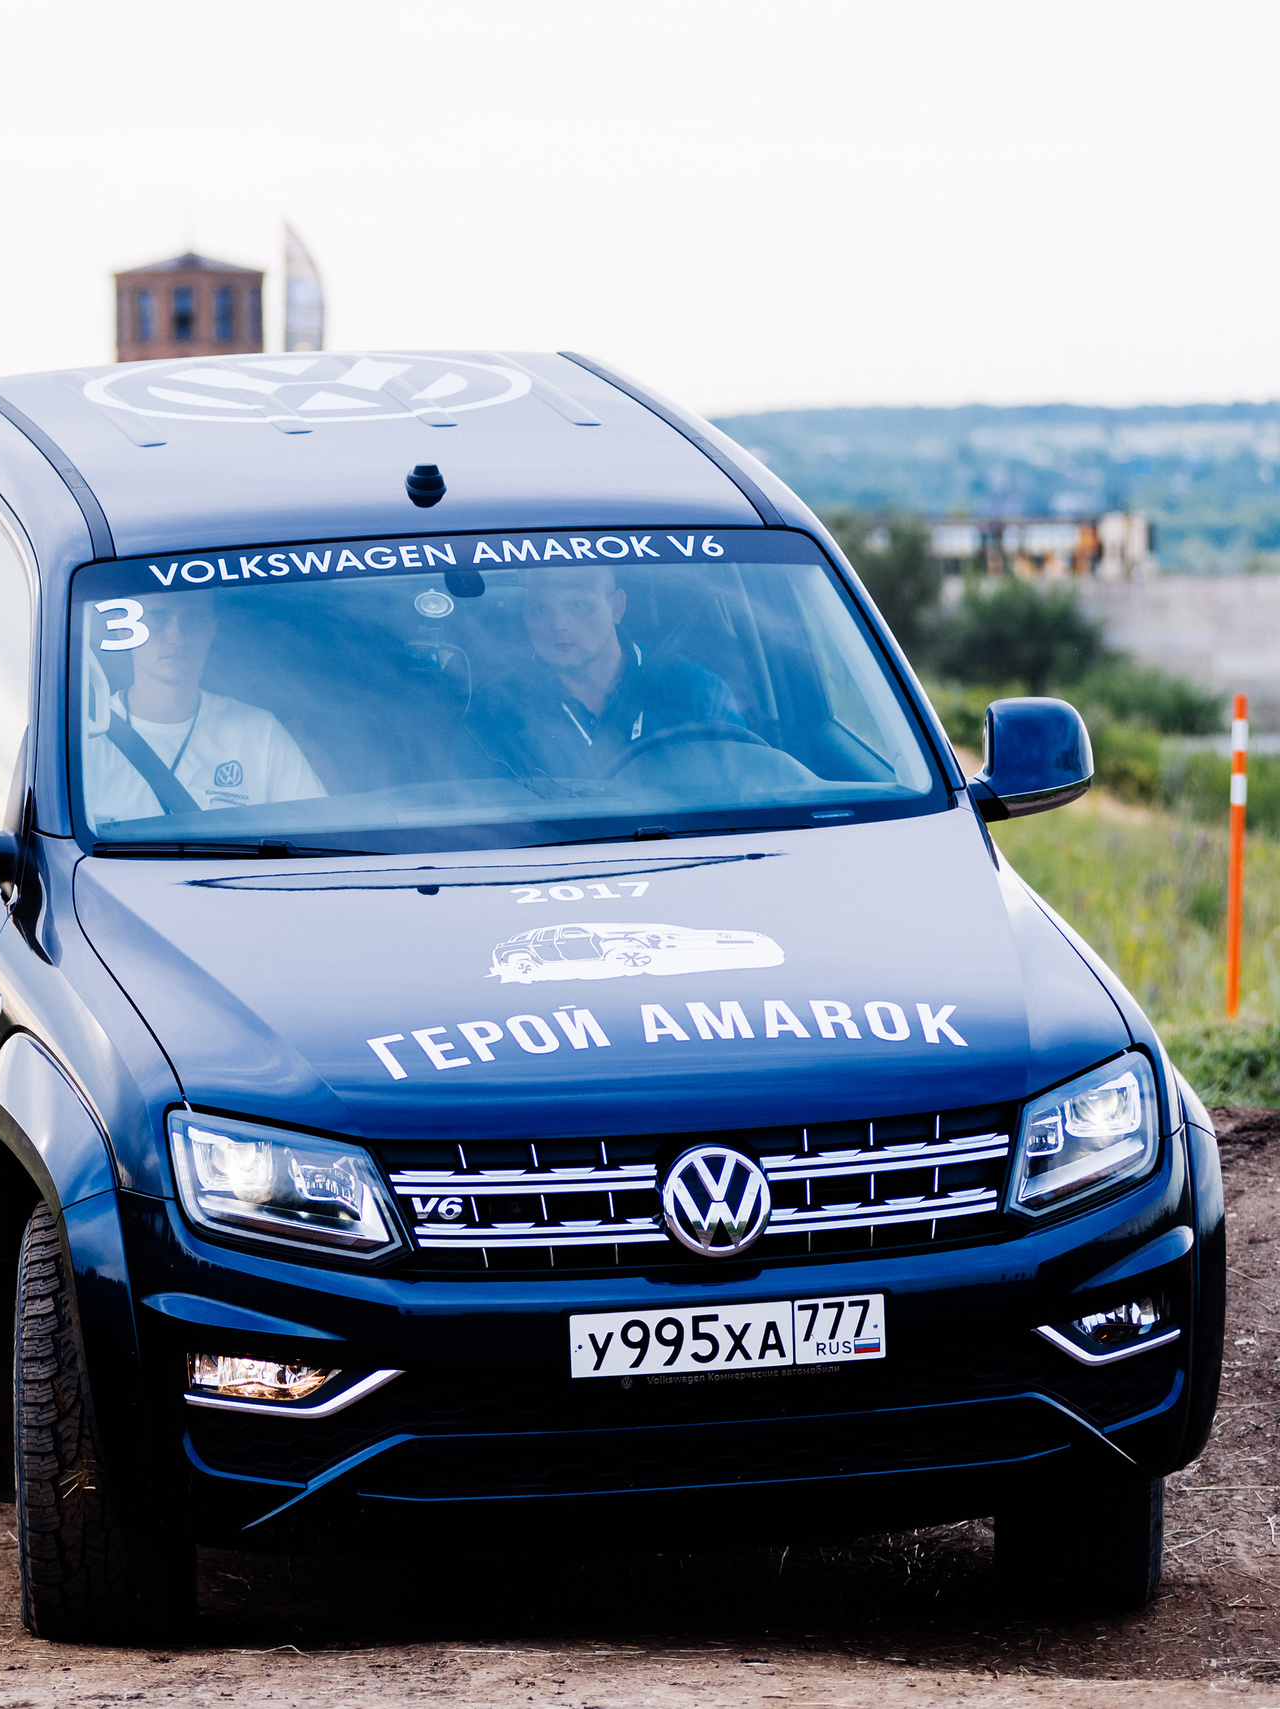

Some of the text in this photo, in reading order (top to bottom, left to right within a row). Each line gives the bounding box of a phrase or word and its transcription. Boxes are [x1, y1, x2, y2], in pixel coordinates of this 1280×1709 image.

[148, 535, 726, 587] VOLKSWAGEN AMAROK V6
[94, 598, 150, 651] 3
[509, 881, 650, 904] 2017
[366, 999, 969, 1081] ГЕРОЙ AMAROK
[411, 1196, 463, 1220] V6
[797, 1299, 870, 1342] 777
[816, 1341, 853, 1356] RUS
[647, 1365, 841, 1385] Volkswagen Коммерческие автомобили
